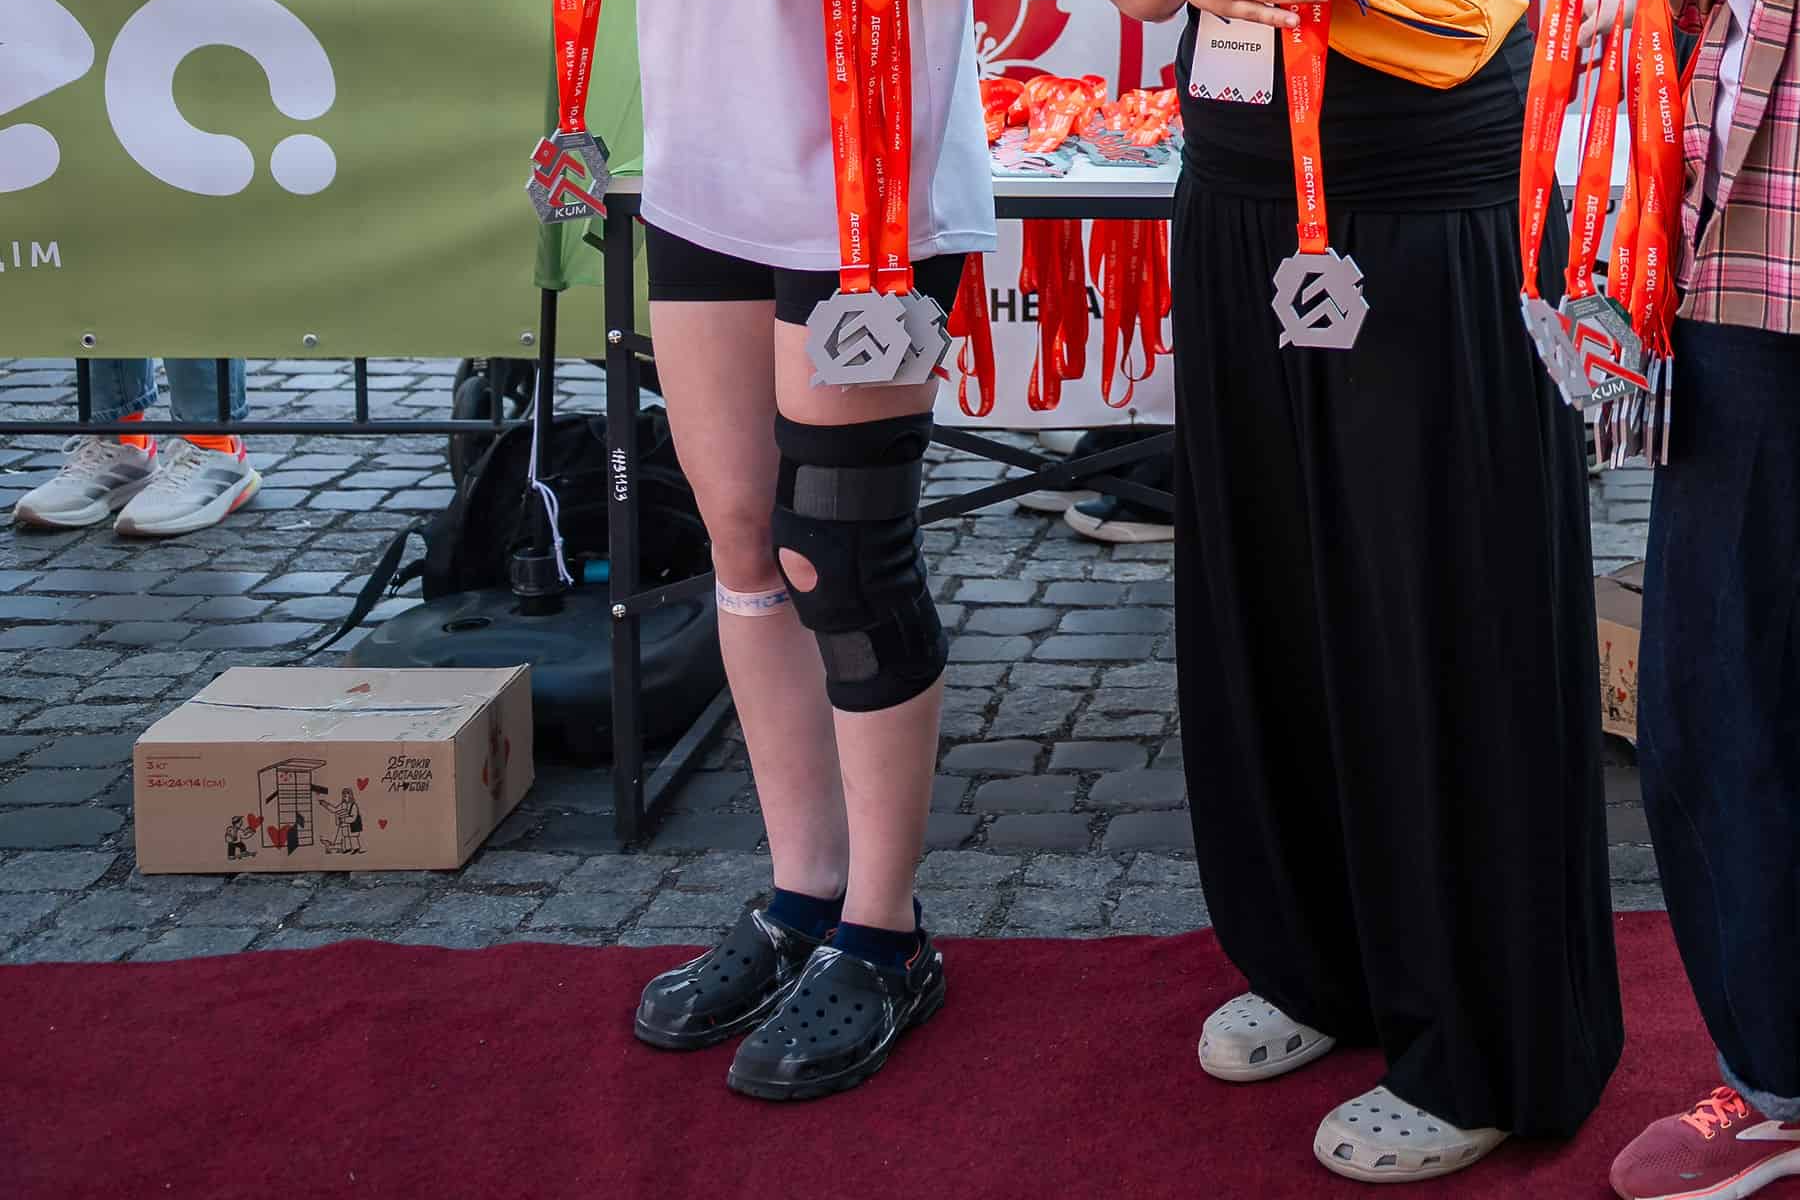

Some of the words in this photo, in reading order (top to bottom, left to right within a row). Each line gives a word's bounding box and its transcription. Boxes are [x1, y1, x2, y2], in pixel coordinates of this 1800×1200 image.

[835, 30, 848, 83] ДЕСЯТКА
[870, 15, 881, 68] ДЕСЯТКА
[1211, 40, 1261, 52] ВОЛОНТЕР
[1651, 31, 1662, 52] КМ
[1658, 86, 1675, 144] ДЕСЯТКА
[1303, 155, 1316, 212] ДЕСЯТКА
[555, 205, 587, 218] KUM
[1581, 195, 1599, 256] ДЕСЯТКА
[849, 212, 862, 264] ДЕСЯТКА
[0, 241, 61, 272] ІМ
[1647, 247, 1658, 267] КМ
[1592, 380, 1626, 400] KUM
[387, 755, 408, 770] 25
